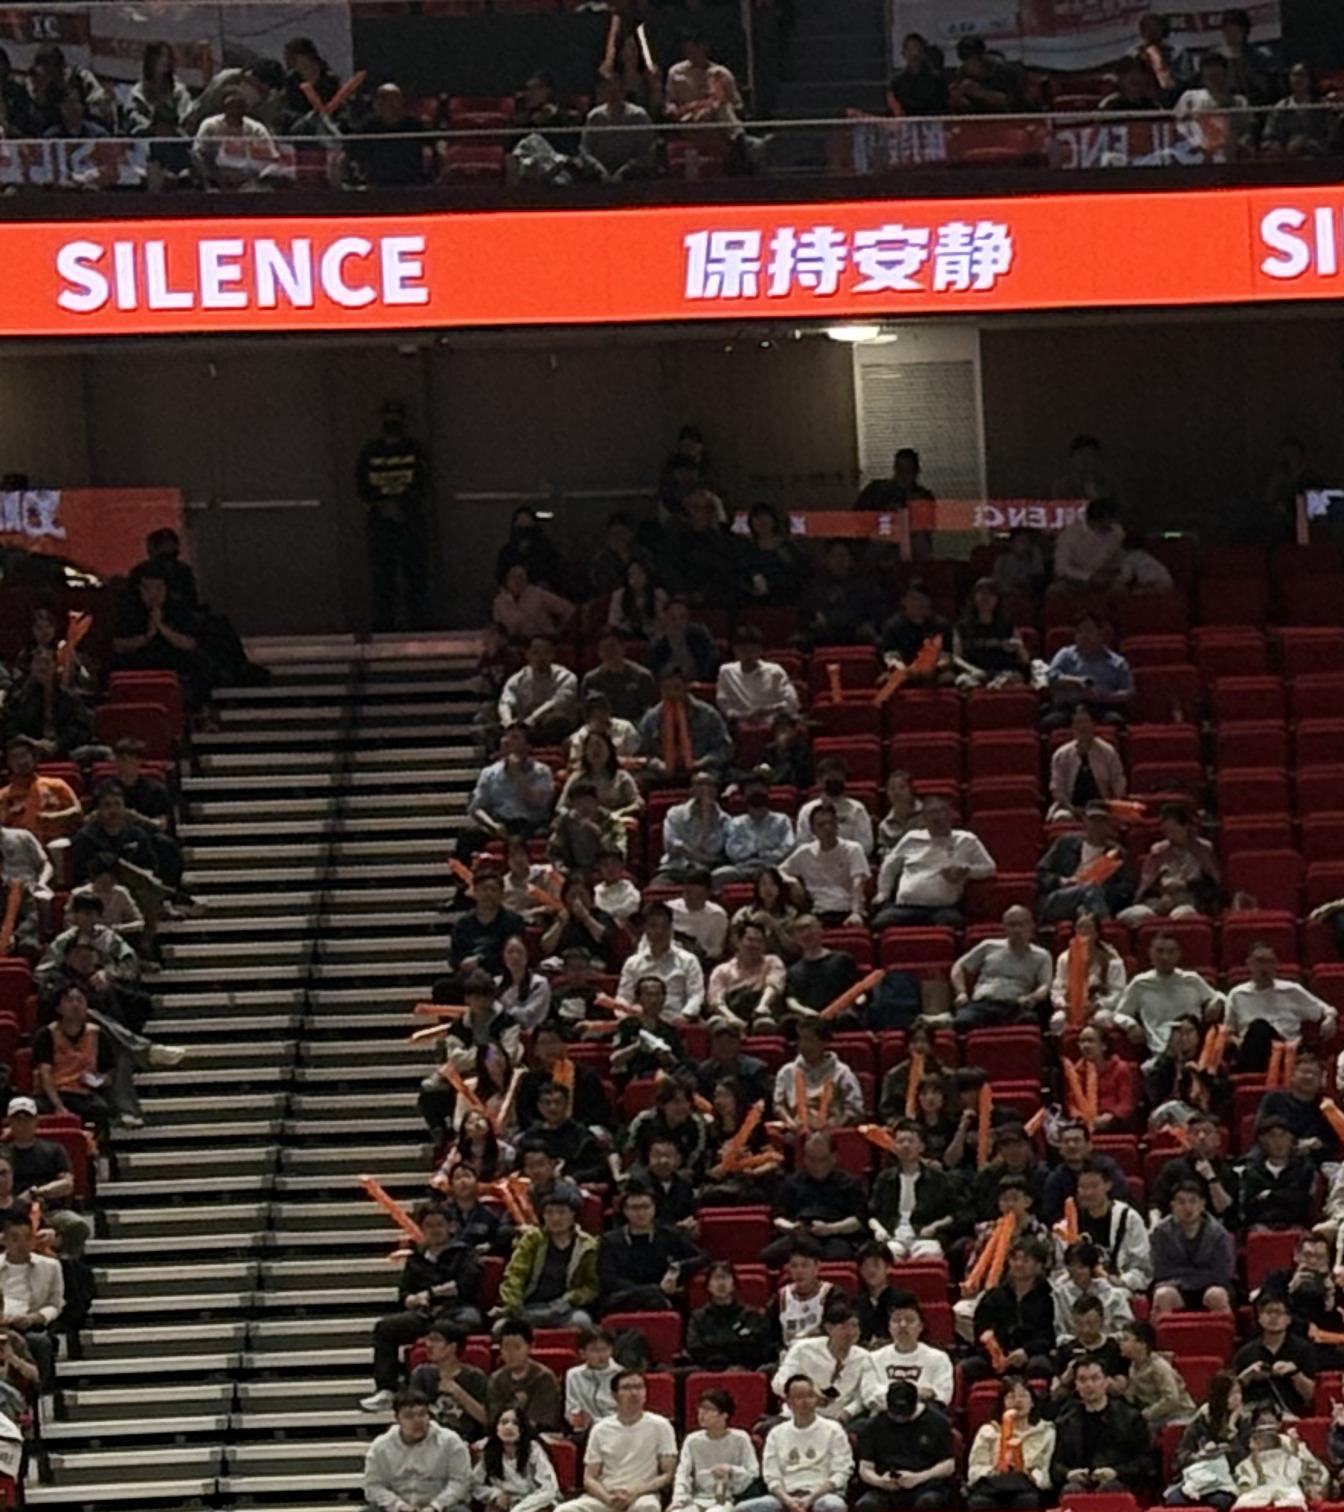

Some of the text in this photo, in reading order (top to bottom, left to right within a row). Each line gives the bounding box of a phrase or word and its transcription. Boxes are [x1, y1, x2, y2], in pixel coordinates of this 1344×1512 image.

[57, 236, 430, 313] SILENCE
[684, 221, 1014, 300] 保持安静
